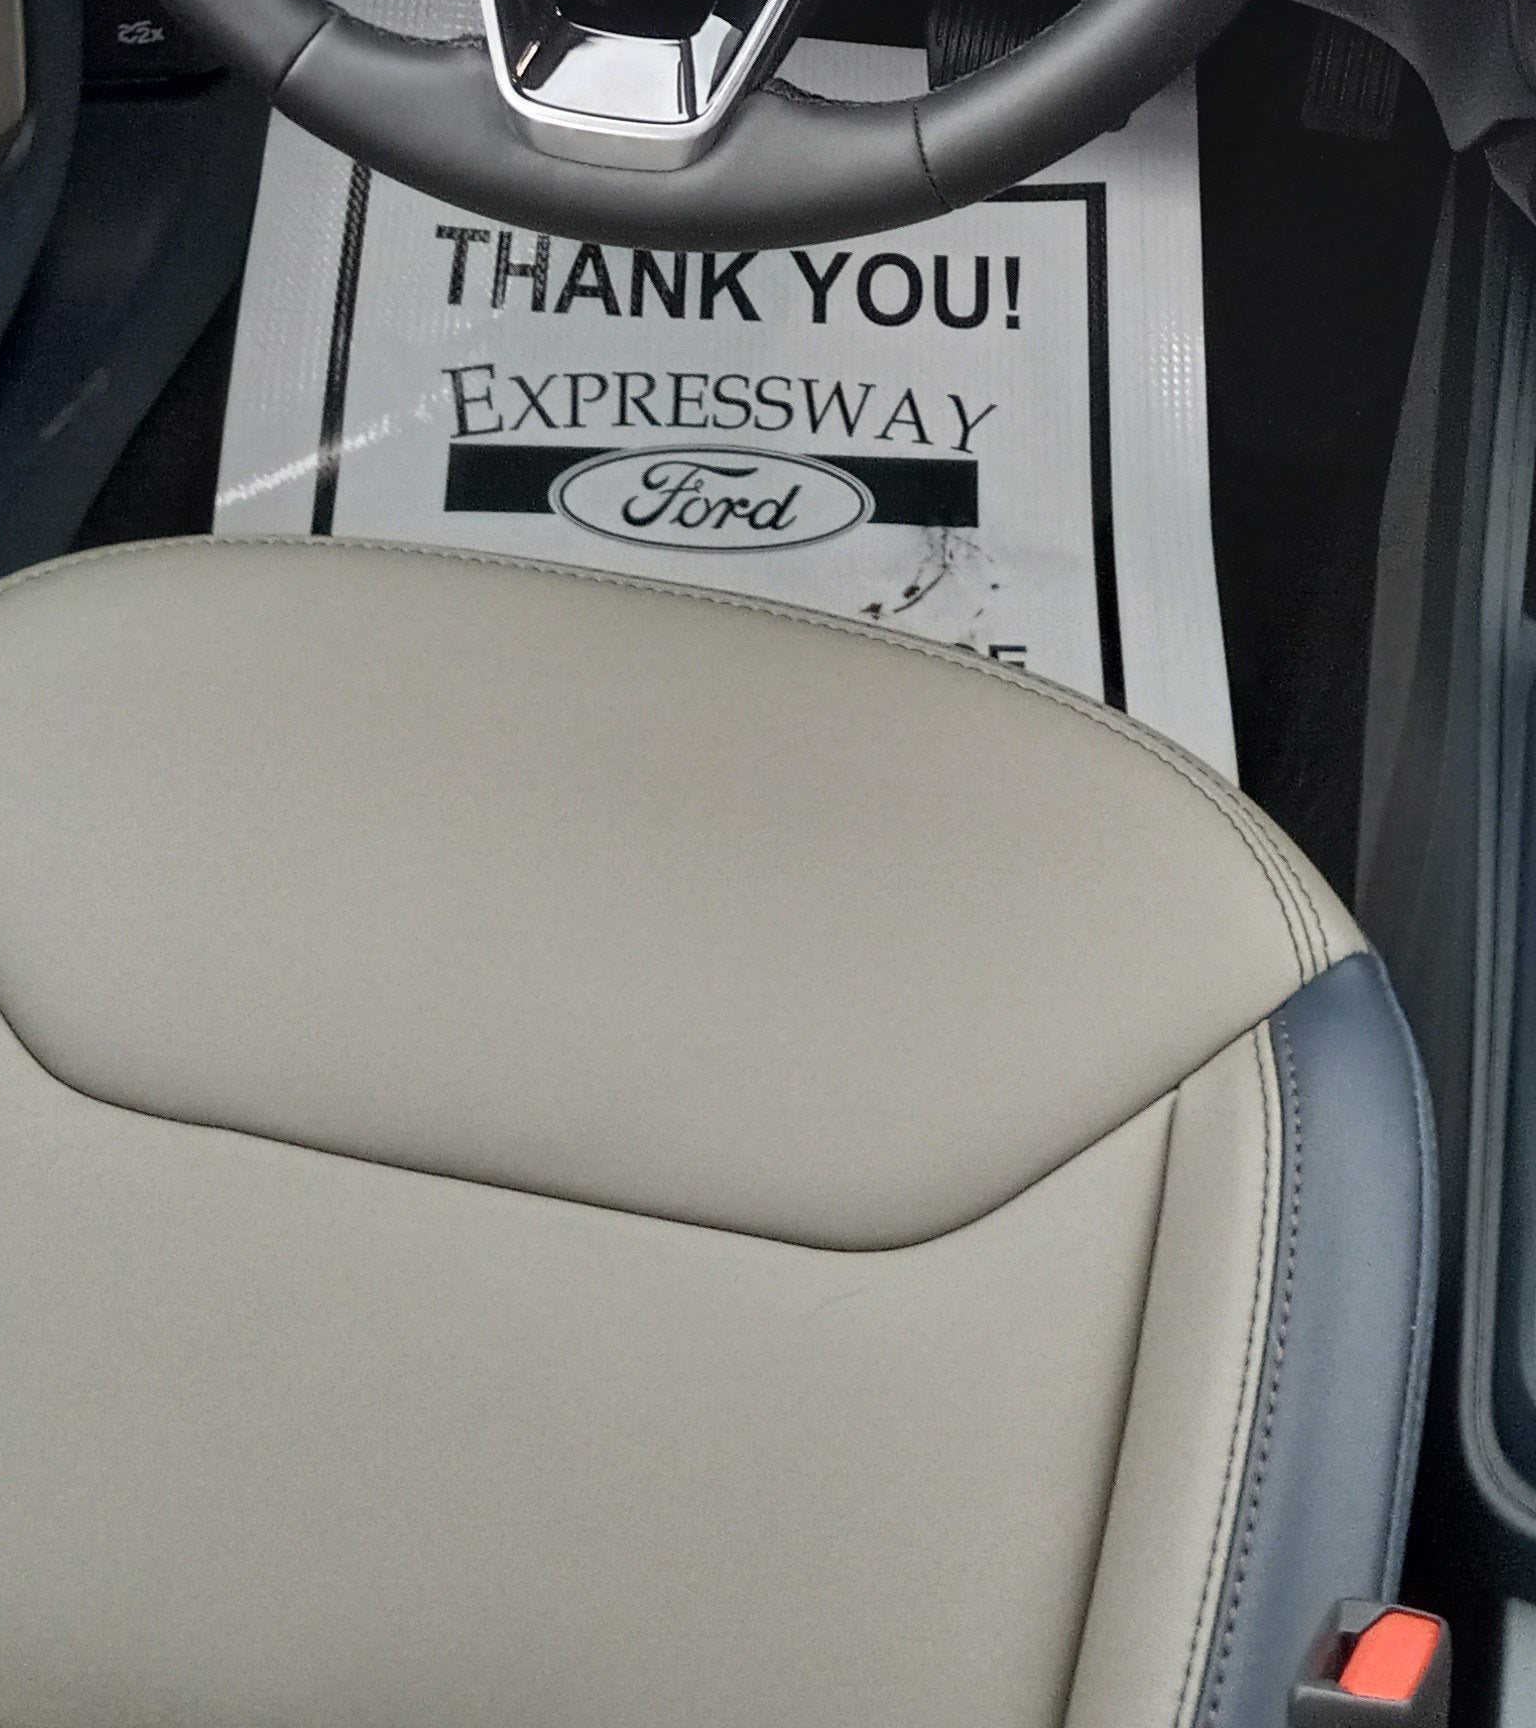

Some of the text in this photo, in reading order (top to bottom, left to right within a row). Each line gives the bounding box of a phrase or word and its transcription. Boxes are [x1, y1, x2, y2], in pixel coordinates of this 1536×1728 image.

[434, 223, 1022, 330] THANK YOU!
[441, 363, 998, 454] EXPRESSWAY
[621, 459, 798, 533] Ford
